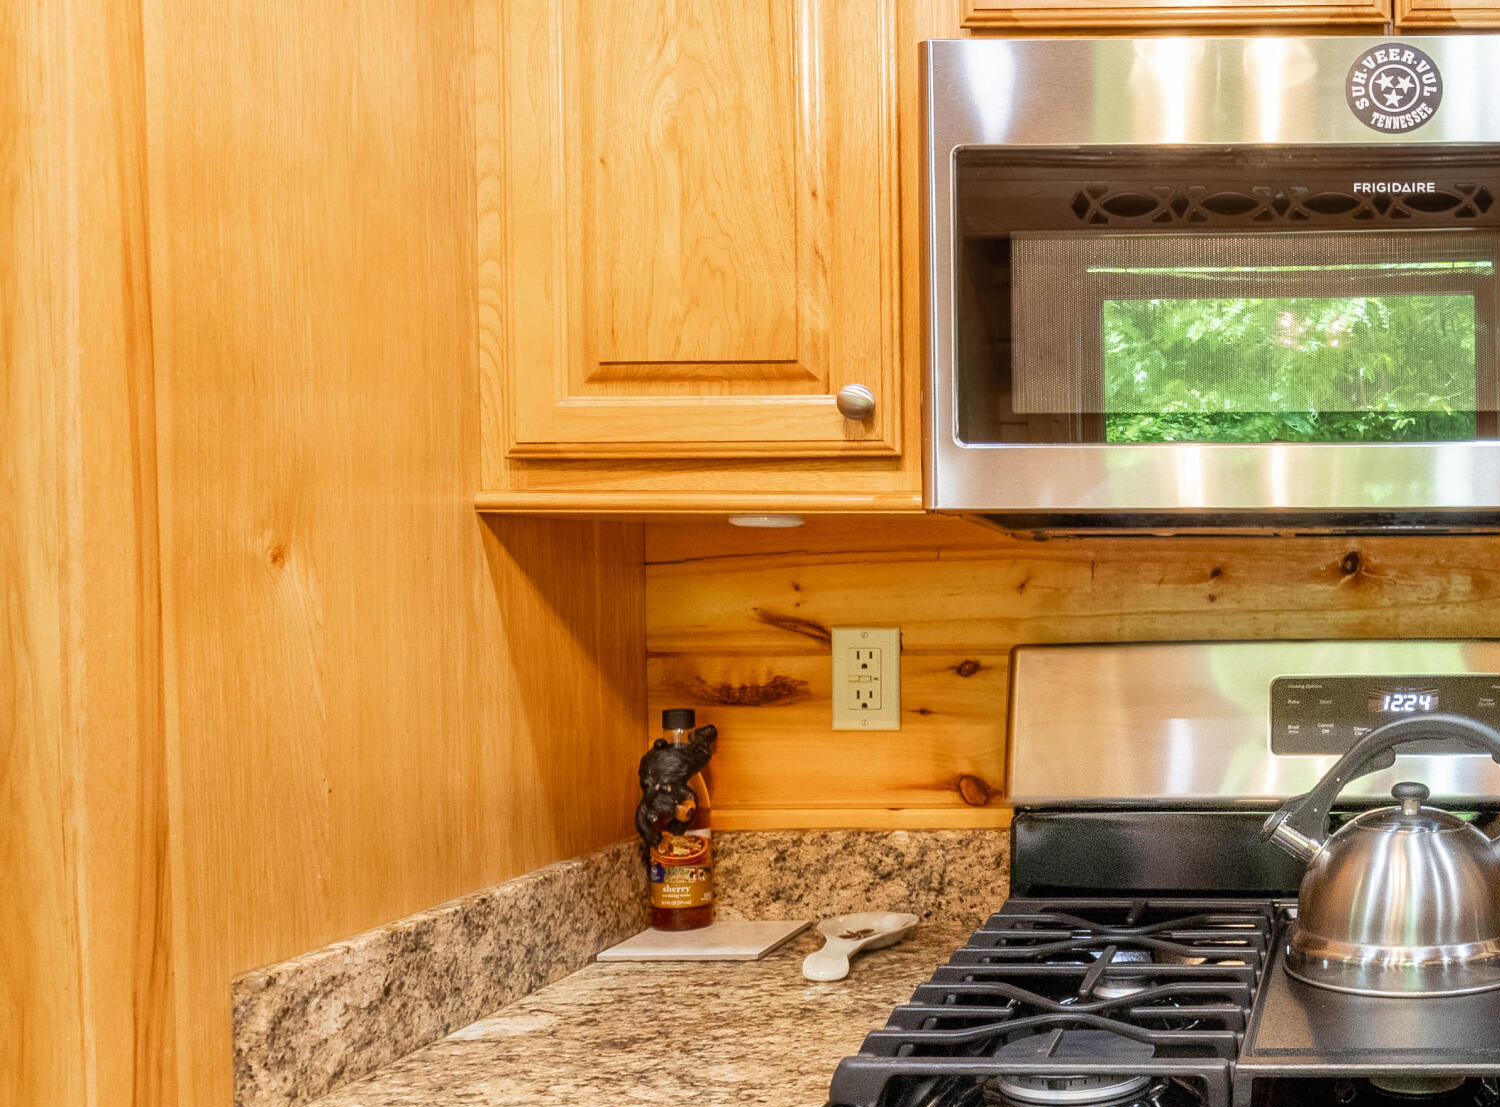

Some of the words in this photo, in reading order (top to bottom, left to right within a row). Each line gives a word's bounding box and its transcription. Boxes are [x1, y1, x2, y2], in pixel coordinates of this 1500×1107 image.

[1370, 102, 1434, 130] TENNESSEE
[1353, 182, 1436, 193] FRIGIDAIRE
[662, 884, 691, 895] sherry
